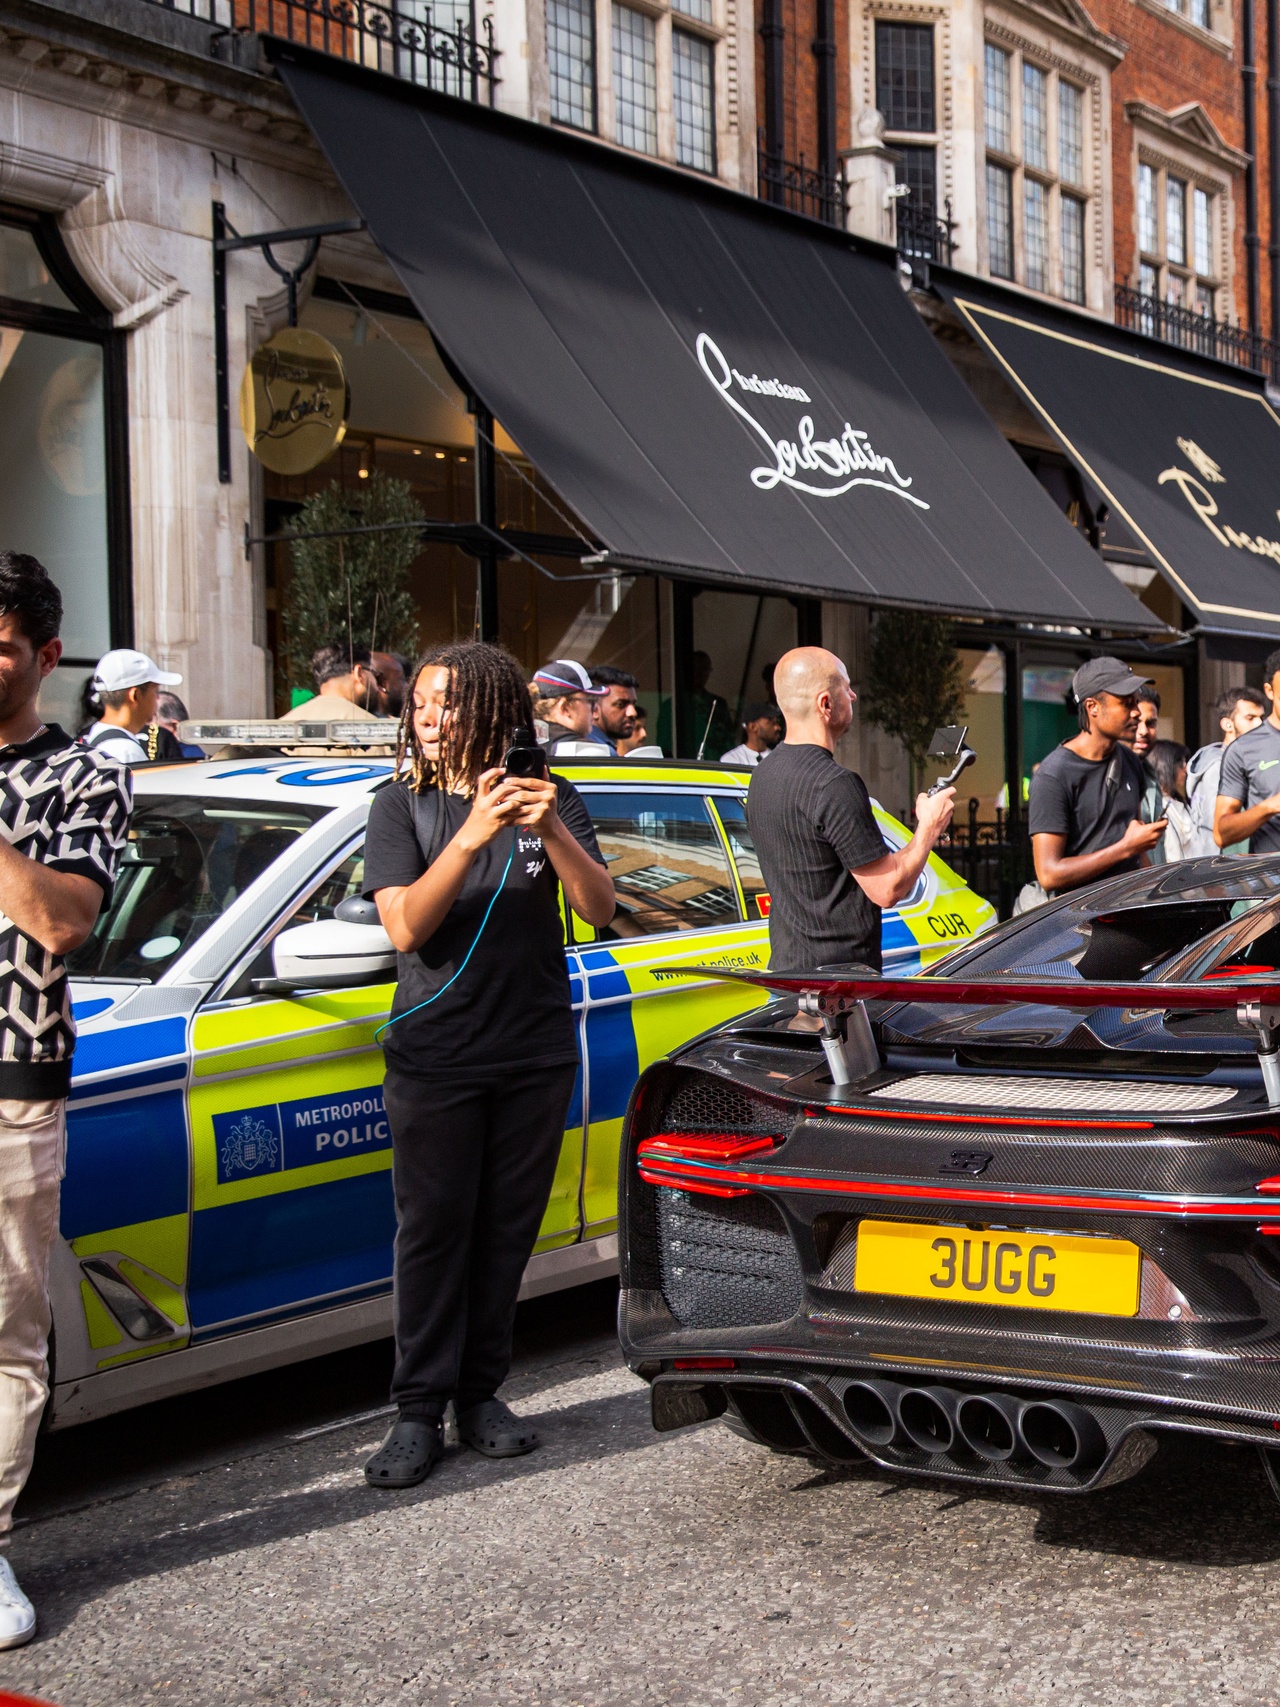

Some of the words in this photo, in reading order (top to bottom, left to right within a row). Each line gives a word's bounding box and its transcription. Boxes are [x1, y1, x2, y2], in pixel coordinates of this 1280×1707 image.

[696, 332, 812, 403] Christian
[750, 415, 931, 510] Louboutin
[927, 913, 972, 938] CUR
[295, 1096, 387, 1128] METROPOLI
[316, 1121, 388, 1151] POLIC
[930, 1237, 1057, 1297] 3UGG
